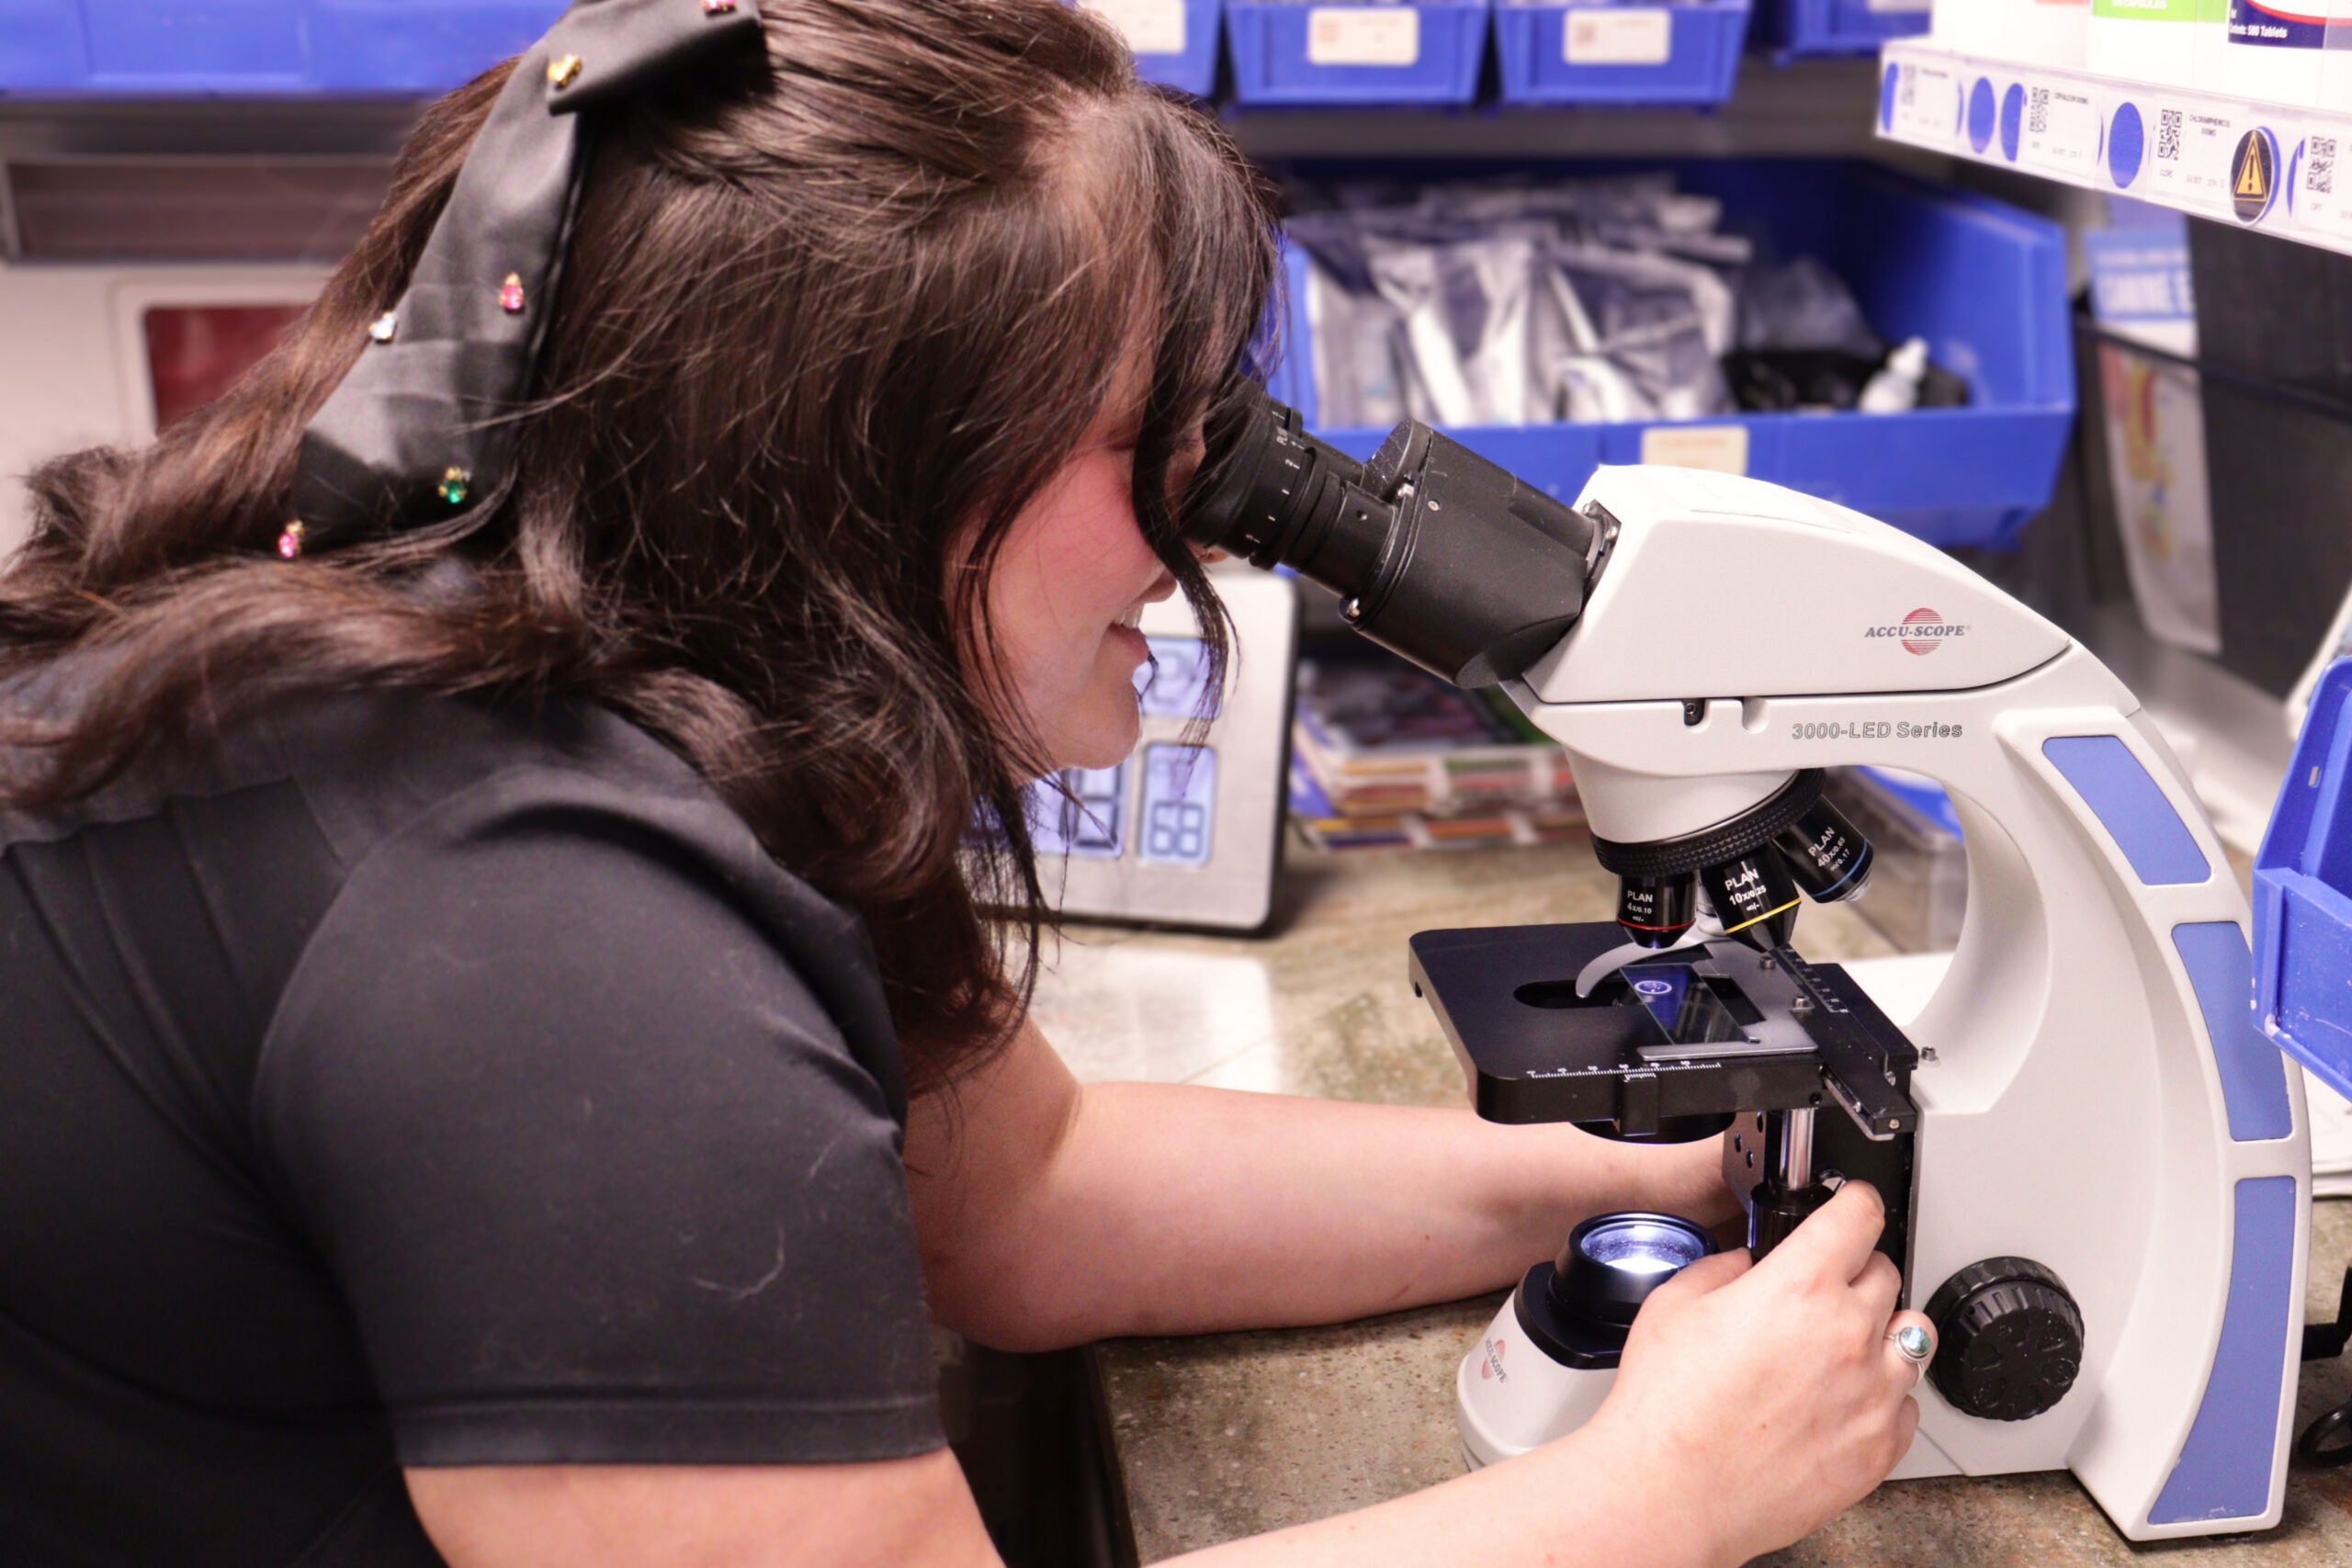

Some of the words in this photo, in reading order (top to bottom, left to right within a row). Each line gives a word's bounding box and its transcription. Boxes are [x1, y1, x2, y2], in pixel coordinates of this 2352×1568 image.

[2260, 25, 2289, 39] Tablets
[1864, 625, 1965, 638] ACCU-SCOPE
[1792, 722, 1891, 739] 3000-LED
[1896, 721, 1962, 738] Series
[1807, 826, 1836, 857] PLAN
[1724, 868, 1759, 891] PLAN
[1627, 890, 1654, 903] PLAN
[1729, 885, 1767, 906] 10x/0.25
[1627, 902, 1653, 915] 4x/0.10
